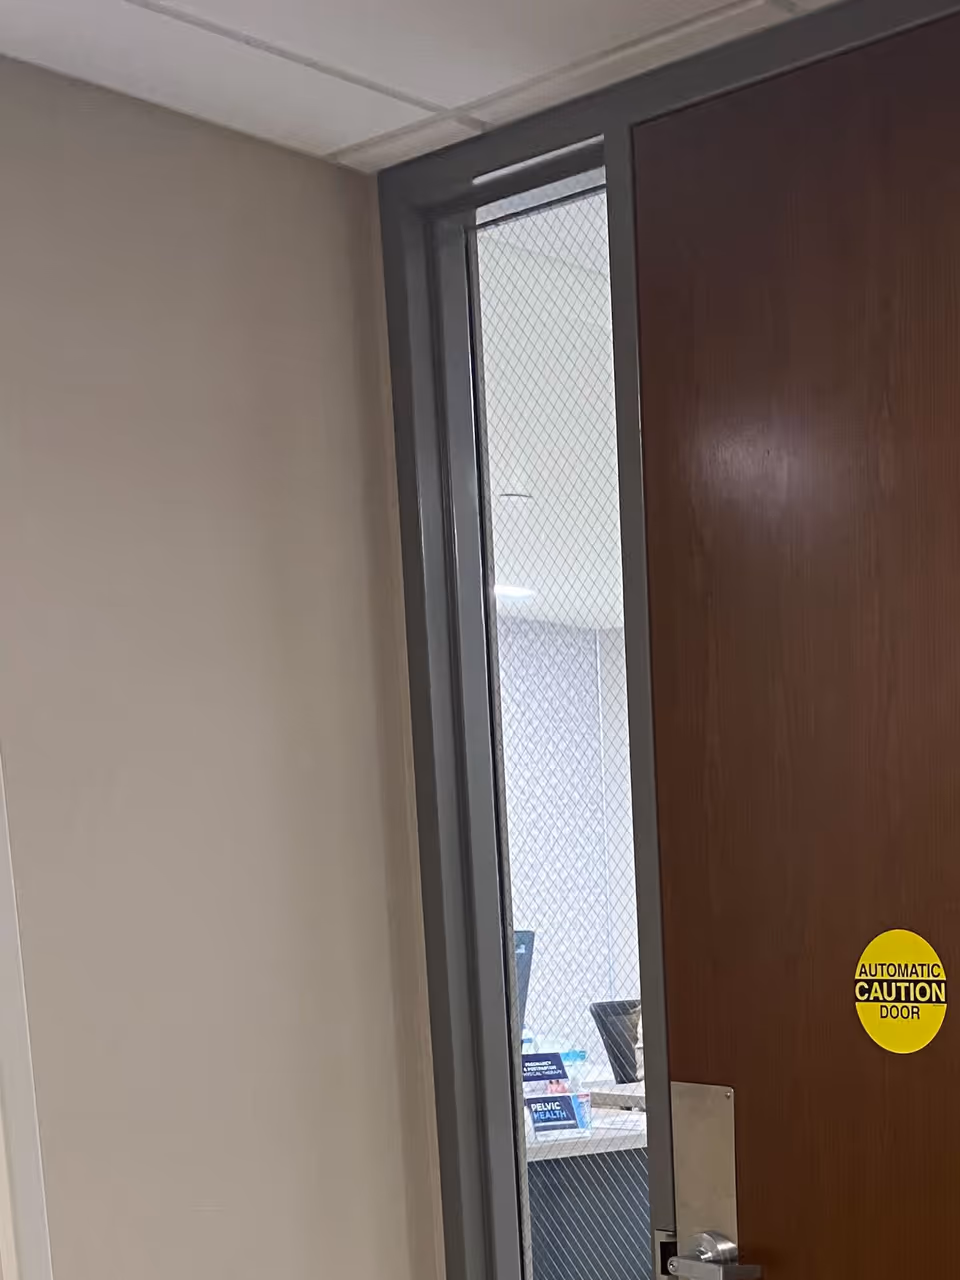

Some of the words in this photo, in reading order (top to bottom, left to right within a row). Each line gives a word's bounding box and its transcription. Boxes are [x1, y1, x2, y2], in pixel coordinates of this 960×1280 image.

[859, 963, 941, 978] AUTOMATIC
[855, 981, 946, 1002] CAUTION
[879, 1005, 920, 1020] DOOR
[531, 1102, 561, 1111] PELVIC
[533, 1110, 566, 1119] HEALTH
